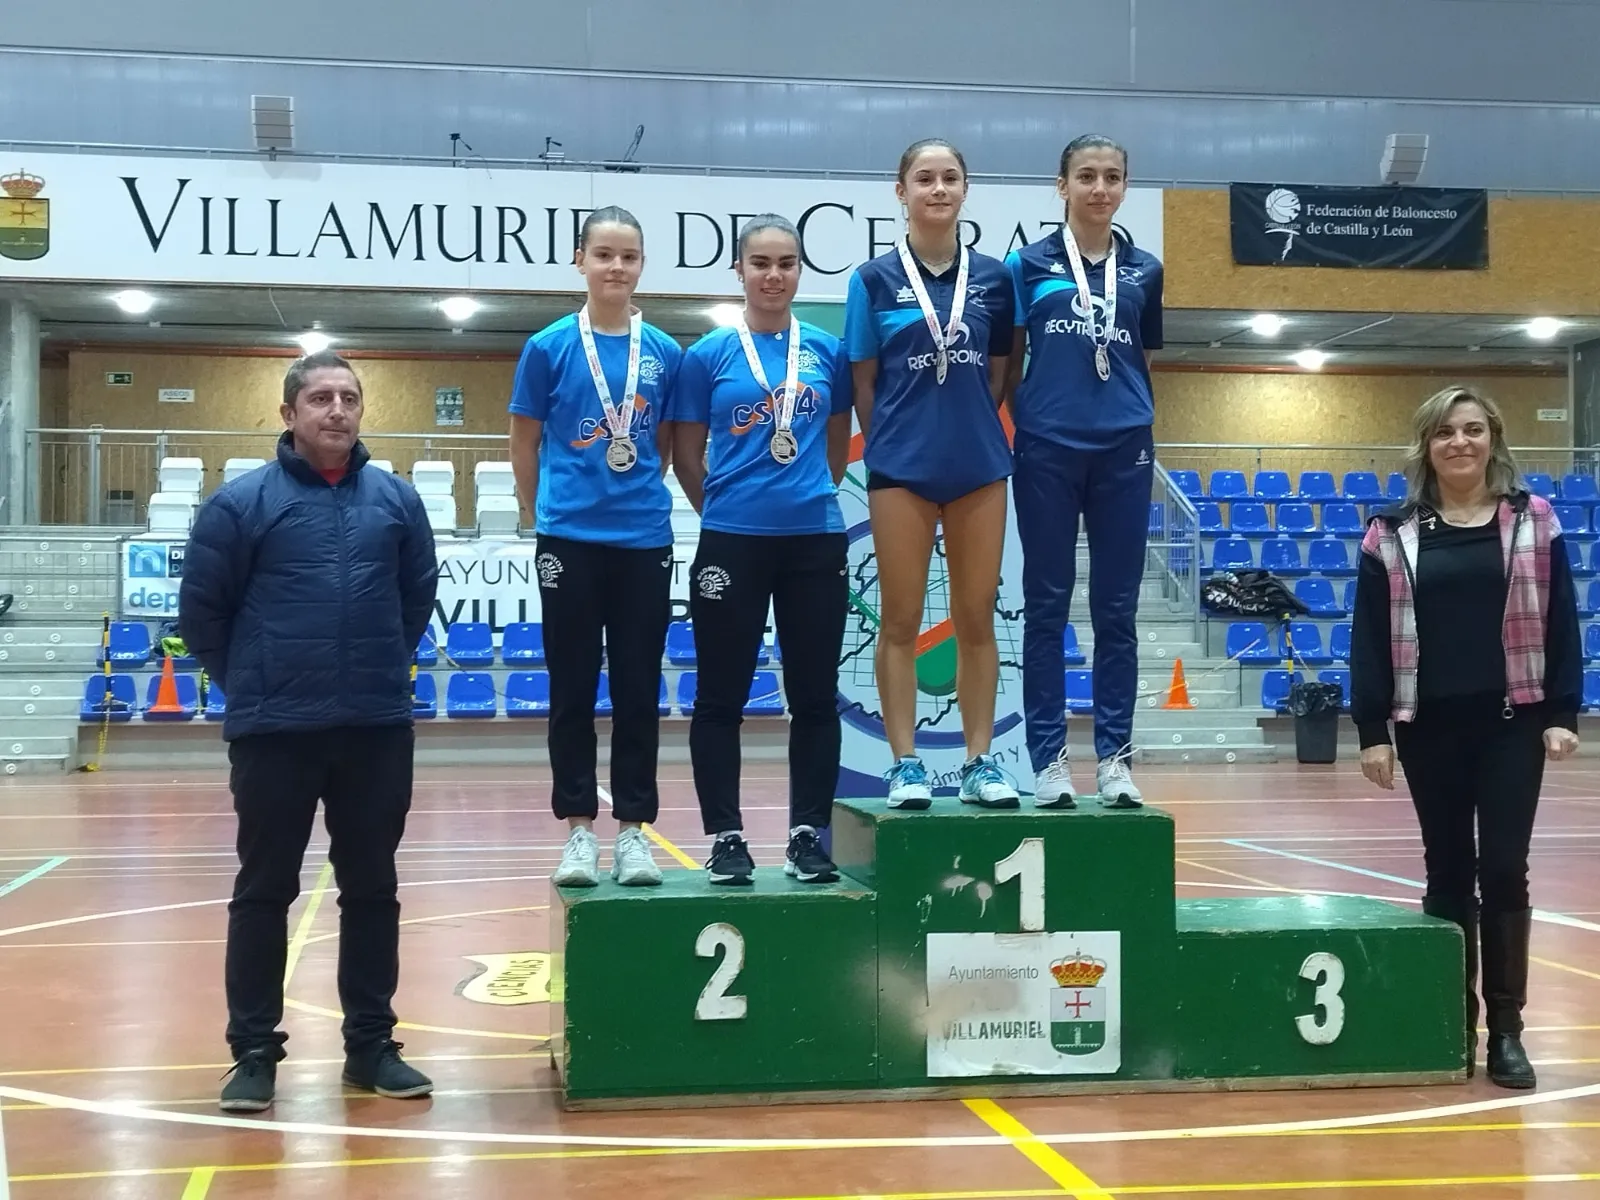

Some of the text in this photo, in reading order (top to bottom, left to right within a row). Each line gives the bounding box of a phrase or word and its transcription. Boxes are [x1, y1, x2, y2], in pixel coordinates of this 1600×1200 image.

[119, 176, 597, 265] VILLAMURIE
[1306, 203, 1458, 220] Federación de Baloncesto
[1306, 222, 1413, 239] de Castilla y León
[129, 586, 179, 613] dep
[995, 837, 1045, 932] 1
[486, 959, 545, 998] CIENCIAS
[694, 922, 748, 1021] 2
[949, 965, 1039, 984] Ayuntamiento
[1295, 952, 1346, 1046] 3
